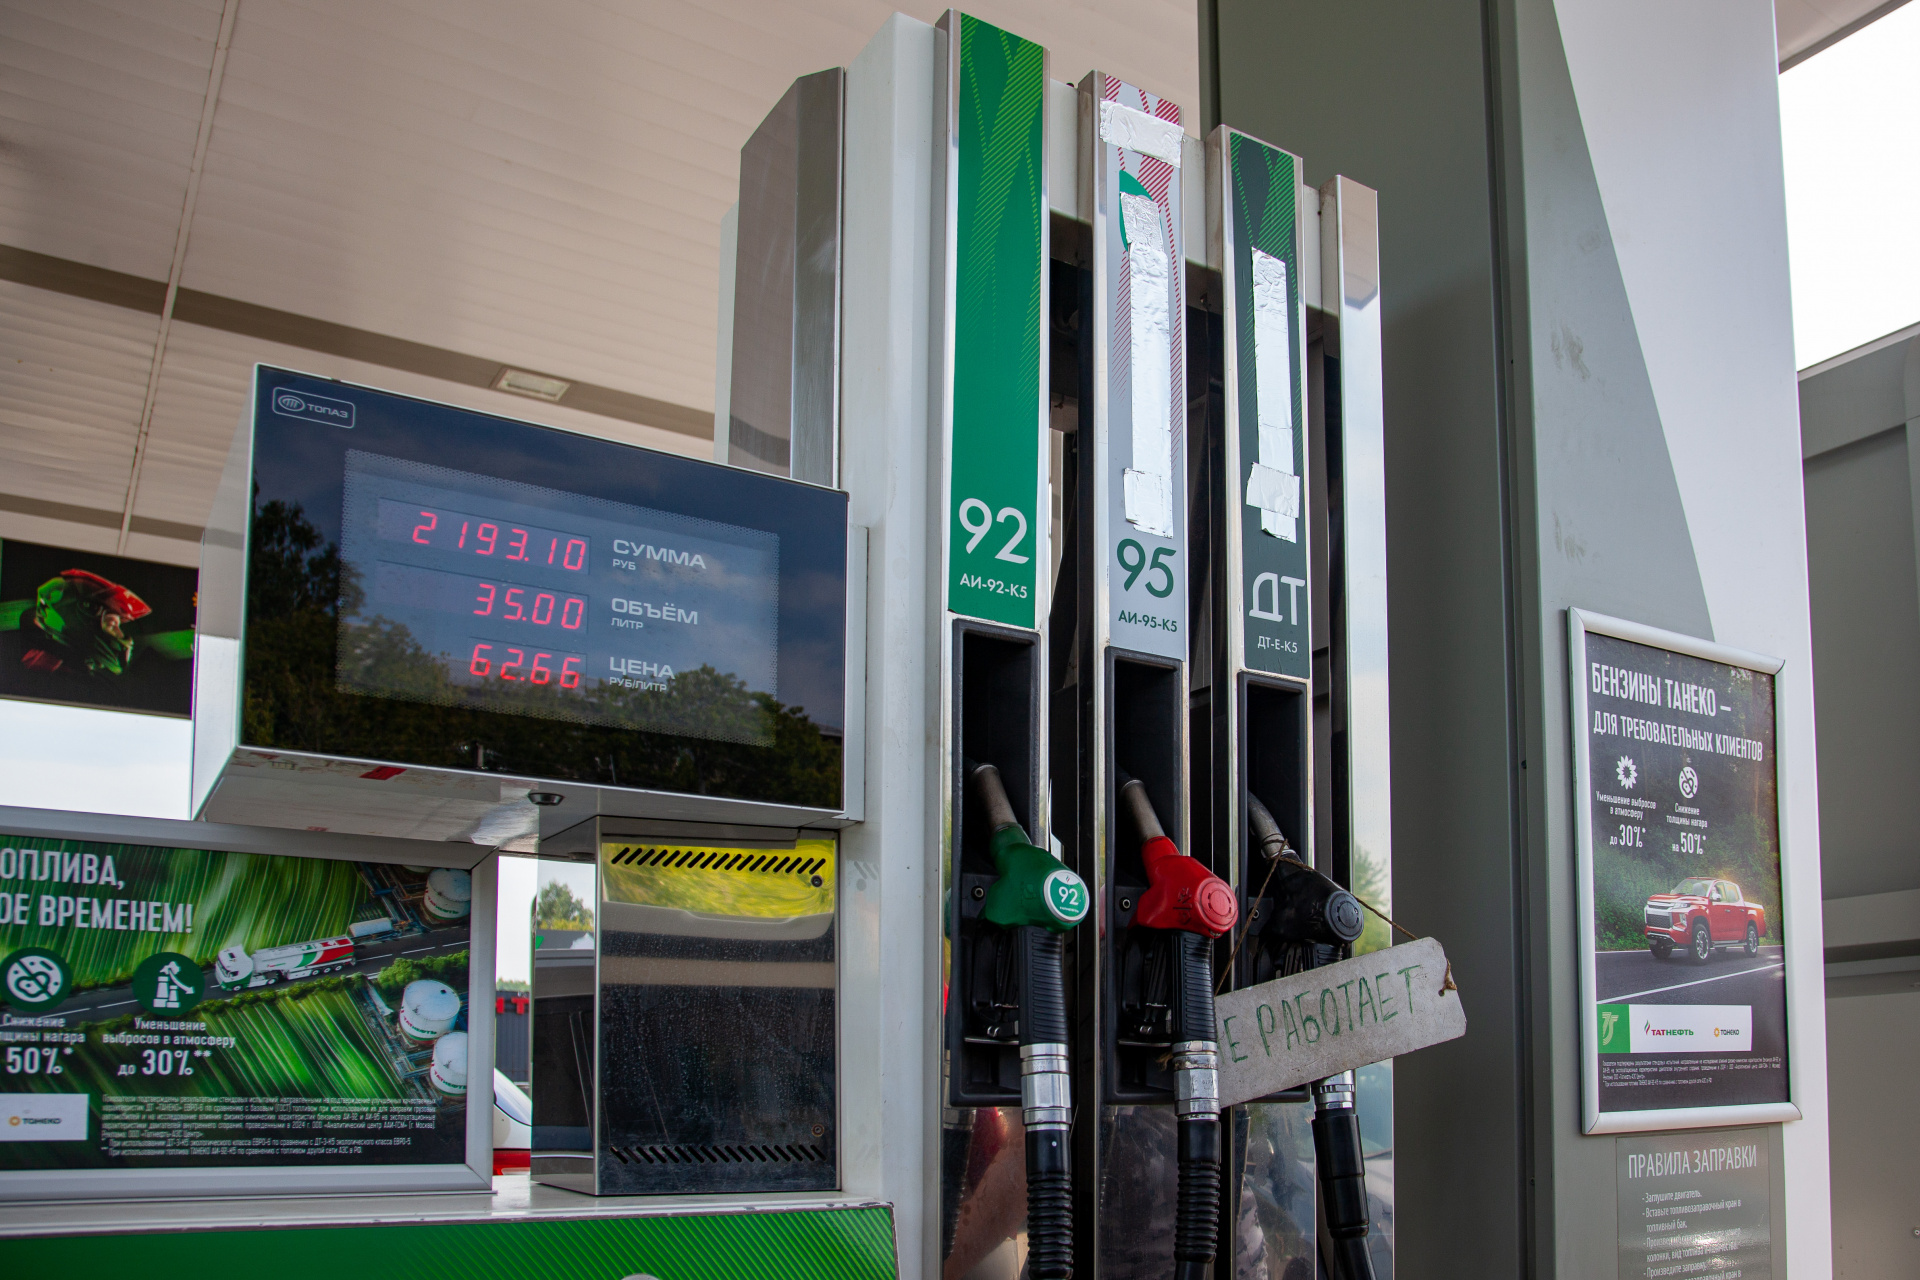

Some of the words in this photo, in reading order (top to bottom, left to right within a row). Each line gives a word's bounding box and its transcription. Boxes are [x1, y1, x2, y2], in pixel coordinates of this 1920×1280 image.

[307, 403, 348, 418] ТОПАЗ
[958, 497, 1030, 564] 92
[412, 511, 587, 571] 2193.10
[612, 539, 706, 570] СУММА
[612, 558, 636, 571] РУБ
[1116, 538, 1177, 599] 95
[959, 573, 1028, 599] АИ-92-К5
[473, 583, 584, 630] 35.00
[1248, 572, 1305, 626] ДТ
[611, 596, 698, 625] ОБЪЁМ
[611, 617, 643, 631] ЛИТР
[1118, 610, 1178, 633] АИ-95-К5
[1257, 635, 1298, 654] ДТ-Е-К5
[470, 644, 580, 689] 62.66
[609, 656, 675, 680] ЦЕНА
[609, 676, 668, 693] РУБ/ЛИТР
[1591, 662, 1661, 707] БЕНЗИНЫ
[1665, 679, 1716, 717] ТАНЕКО
[1593, 711, 1618, 735] ДЛЯ
[1620, 715, 1713, 753] ТРЕБОВАТЕЛЬНЫХ
[1715, 734, 1763, 762] КЛИЕНТОВ
[1596, 790, 1630, 806] Уменьшение
[1631, 797, 1657, 809] выбросов
[1614, 807, 1644, 821] атмосферу
[1674, 802, 1700, 816] Снижение
[1666, 815, 1690, 825] толщины
[1690, 818, 1708, 829] нагара
[1609, 835, 1618, 846] до
[1672, 843, 1679, 852] на
[1058, 886, 1079, 906] 92
[39, 895, 193, 933] ВРЕМЕНЕМ!
[1256, 964, 1422, 1057] РАБОТАЕТ
[3, 1013, 66, 1028] Снижение
[134, 1017, 207, 1031] Уменьшение
[43, 1032, 86, 1045] нагара
[102, 1032, 159, 1046] выбросов
[163, 1035, 169, 1044] в
[173, 1035, 236, 1048] атмосферу
[1651, 1028, 1694, 1036] ТАТНЕФТЬ
[117, 1064, 136, 1076] до
[1628, 1151, 1691, 1179] ПРАВИЛА
[1693, 1145, 1757, 1174] ЗАПРАВКИ
[1645, 1192, 1674, 1204] Заглушите
[1674, 1190, 1702, 1201] двигатель.
[1645, 1206, 1669, 1218] Вставьте
[1670, 1200, 1725, 1214] топливозаправочный
[1725, 1200, 1737, 1210] кран
[1646, 1219, 1676, 1233] топливный
[1646, 1262, 1682, 1279] Произведите
